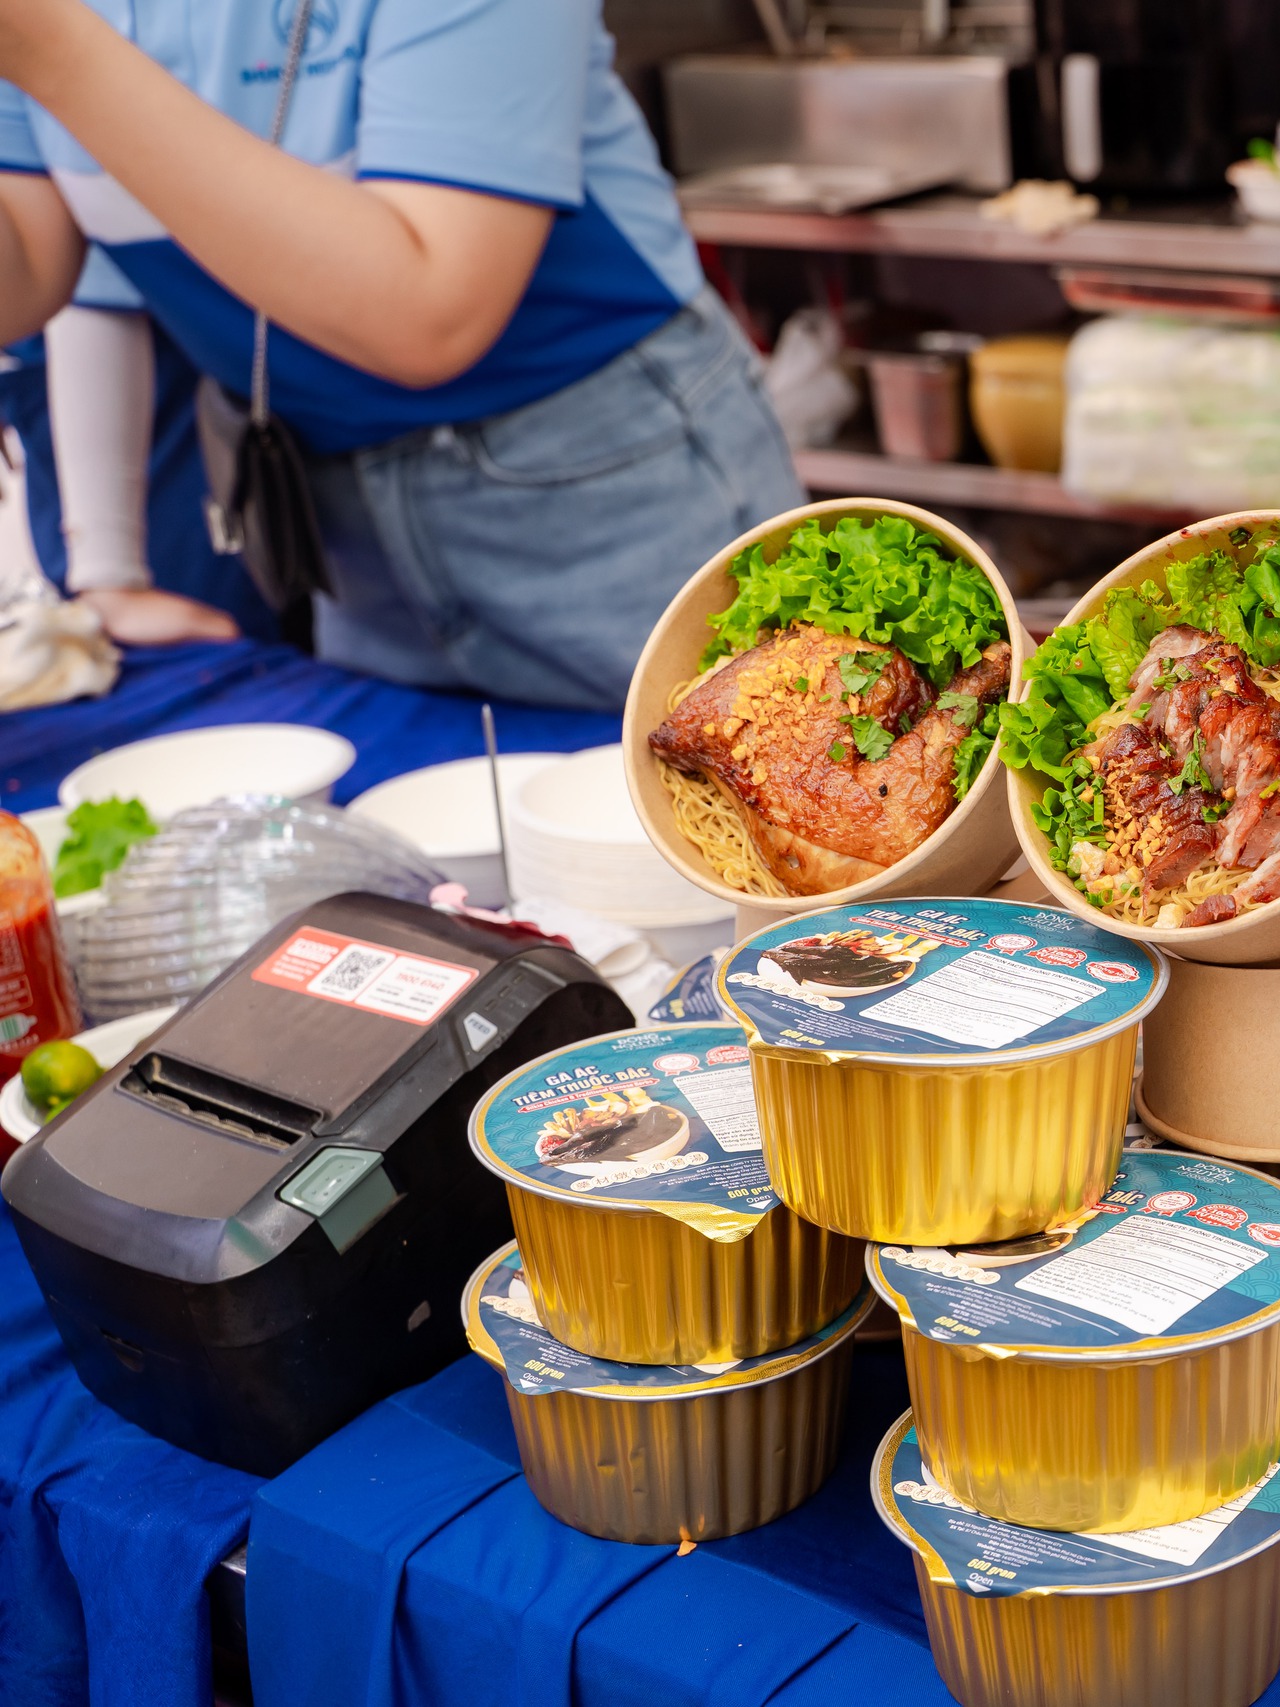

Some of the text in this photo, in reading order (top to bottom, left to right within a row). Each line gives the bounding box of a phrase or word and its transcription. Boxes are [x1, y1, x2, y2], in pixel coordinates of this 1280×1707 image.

[467, 1017, 491, 1035] FEED
[727, 1189, 749, 1199] 600
[746, 1194, 771, 1203] Open
[934, 1316, 981, 1337] 600 gram
[523, 1372, 543, 1383] Open
[524, 1359, 565, 1380] 600 gram
[967, 1558, 1017, 1580] 600 gram
[969, 1572, 994, 1586] Open
